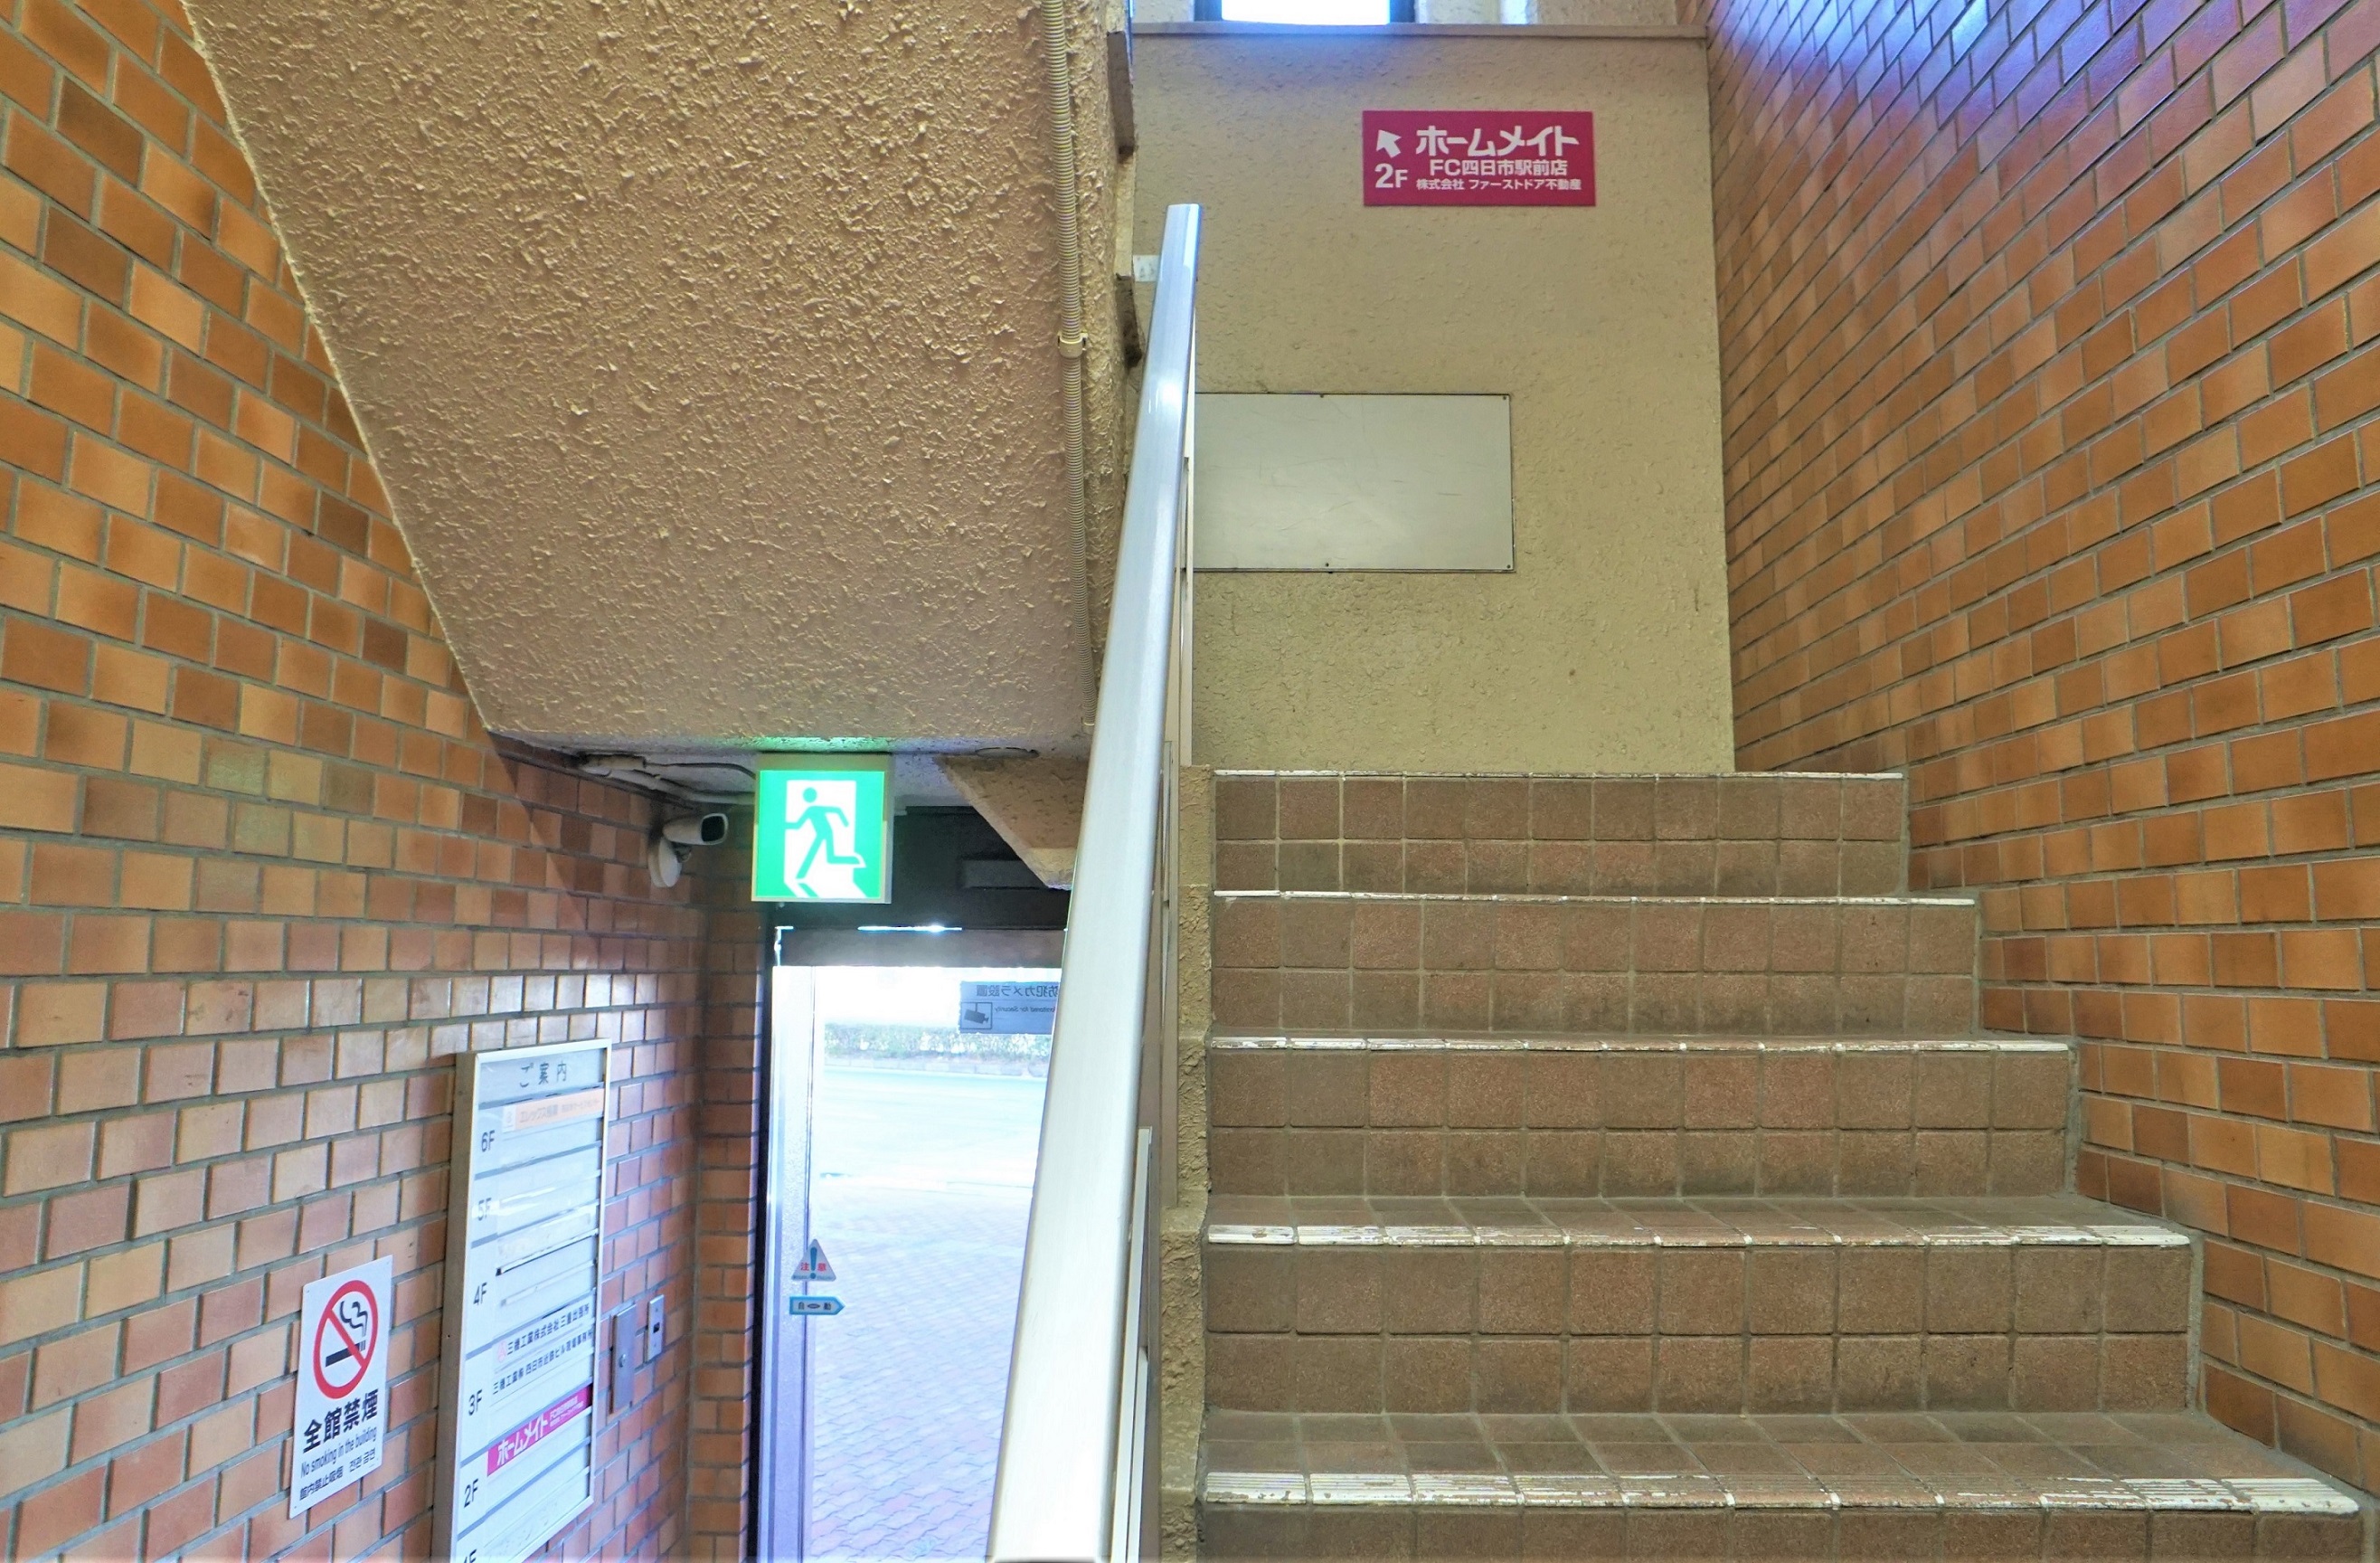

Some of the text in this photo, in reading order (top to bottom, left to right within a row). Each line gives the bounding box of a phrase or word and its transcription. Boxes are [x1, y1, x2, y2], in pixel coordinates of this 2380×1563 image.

[1416, 125, 1580, 156] ホームメイト
[1374, 163, 1408, 188] 2F
[1430, 159, 1568, 176] FC四日市駅前店
[1416, 178, 1582, 191] 株式会社 ファーストドア不動産
[520, 1061, 567, 1087] ご案内
[481, 1130, 495, 1152] 6F
[477, 1198, 492, 1221] 5F
[473, 1282, 487, 1305] 4F
[468, 1389, 483, 1416] 3F
[303, 1388, 379, 1454] 全館禁煙
[497, 1413, 548, 1465] ホームメイト
[300, 1461, 309, 1478] No
[311, 1448, 337, 1473] smoking
[464, 1478, 479, 1508] 2F
